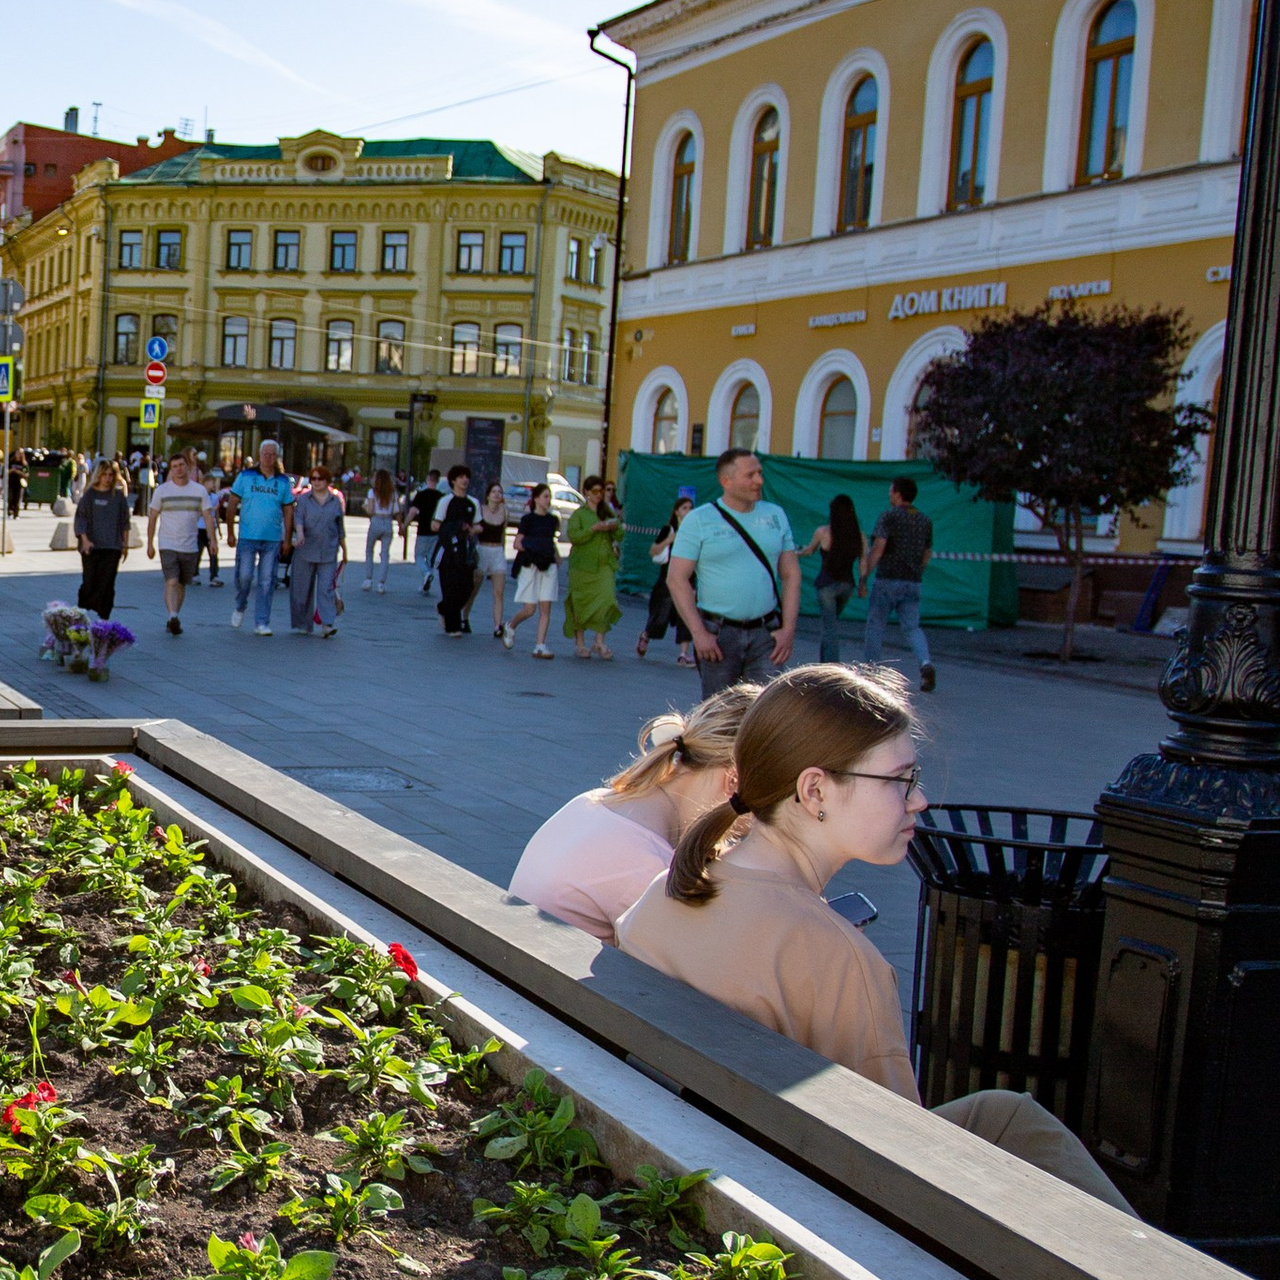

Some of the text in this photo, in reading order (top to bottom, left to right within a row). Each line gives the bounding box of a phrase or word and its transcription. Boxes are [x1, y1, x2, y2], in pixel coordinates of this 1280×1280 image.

[888, 281, 1007, 321] ДОМ КНИГИ
[251, 484, 279, 496] ENGLAND
